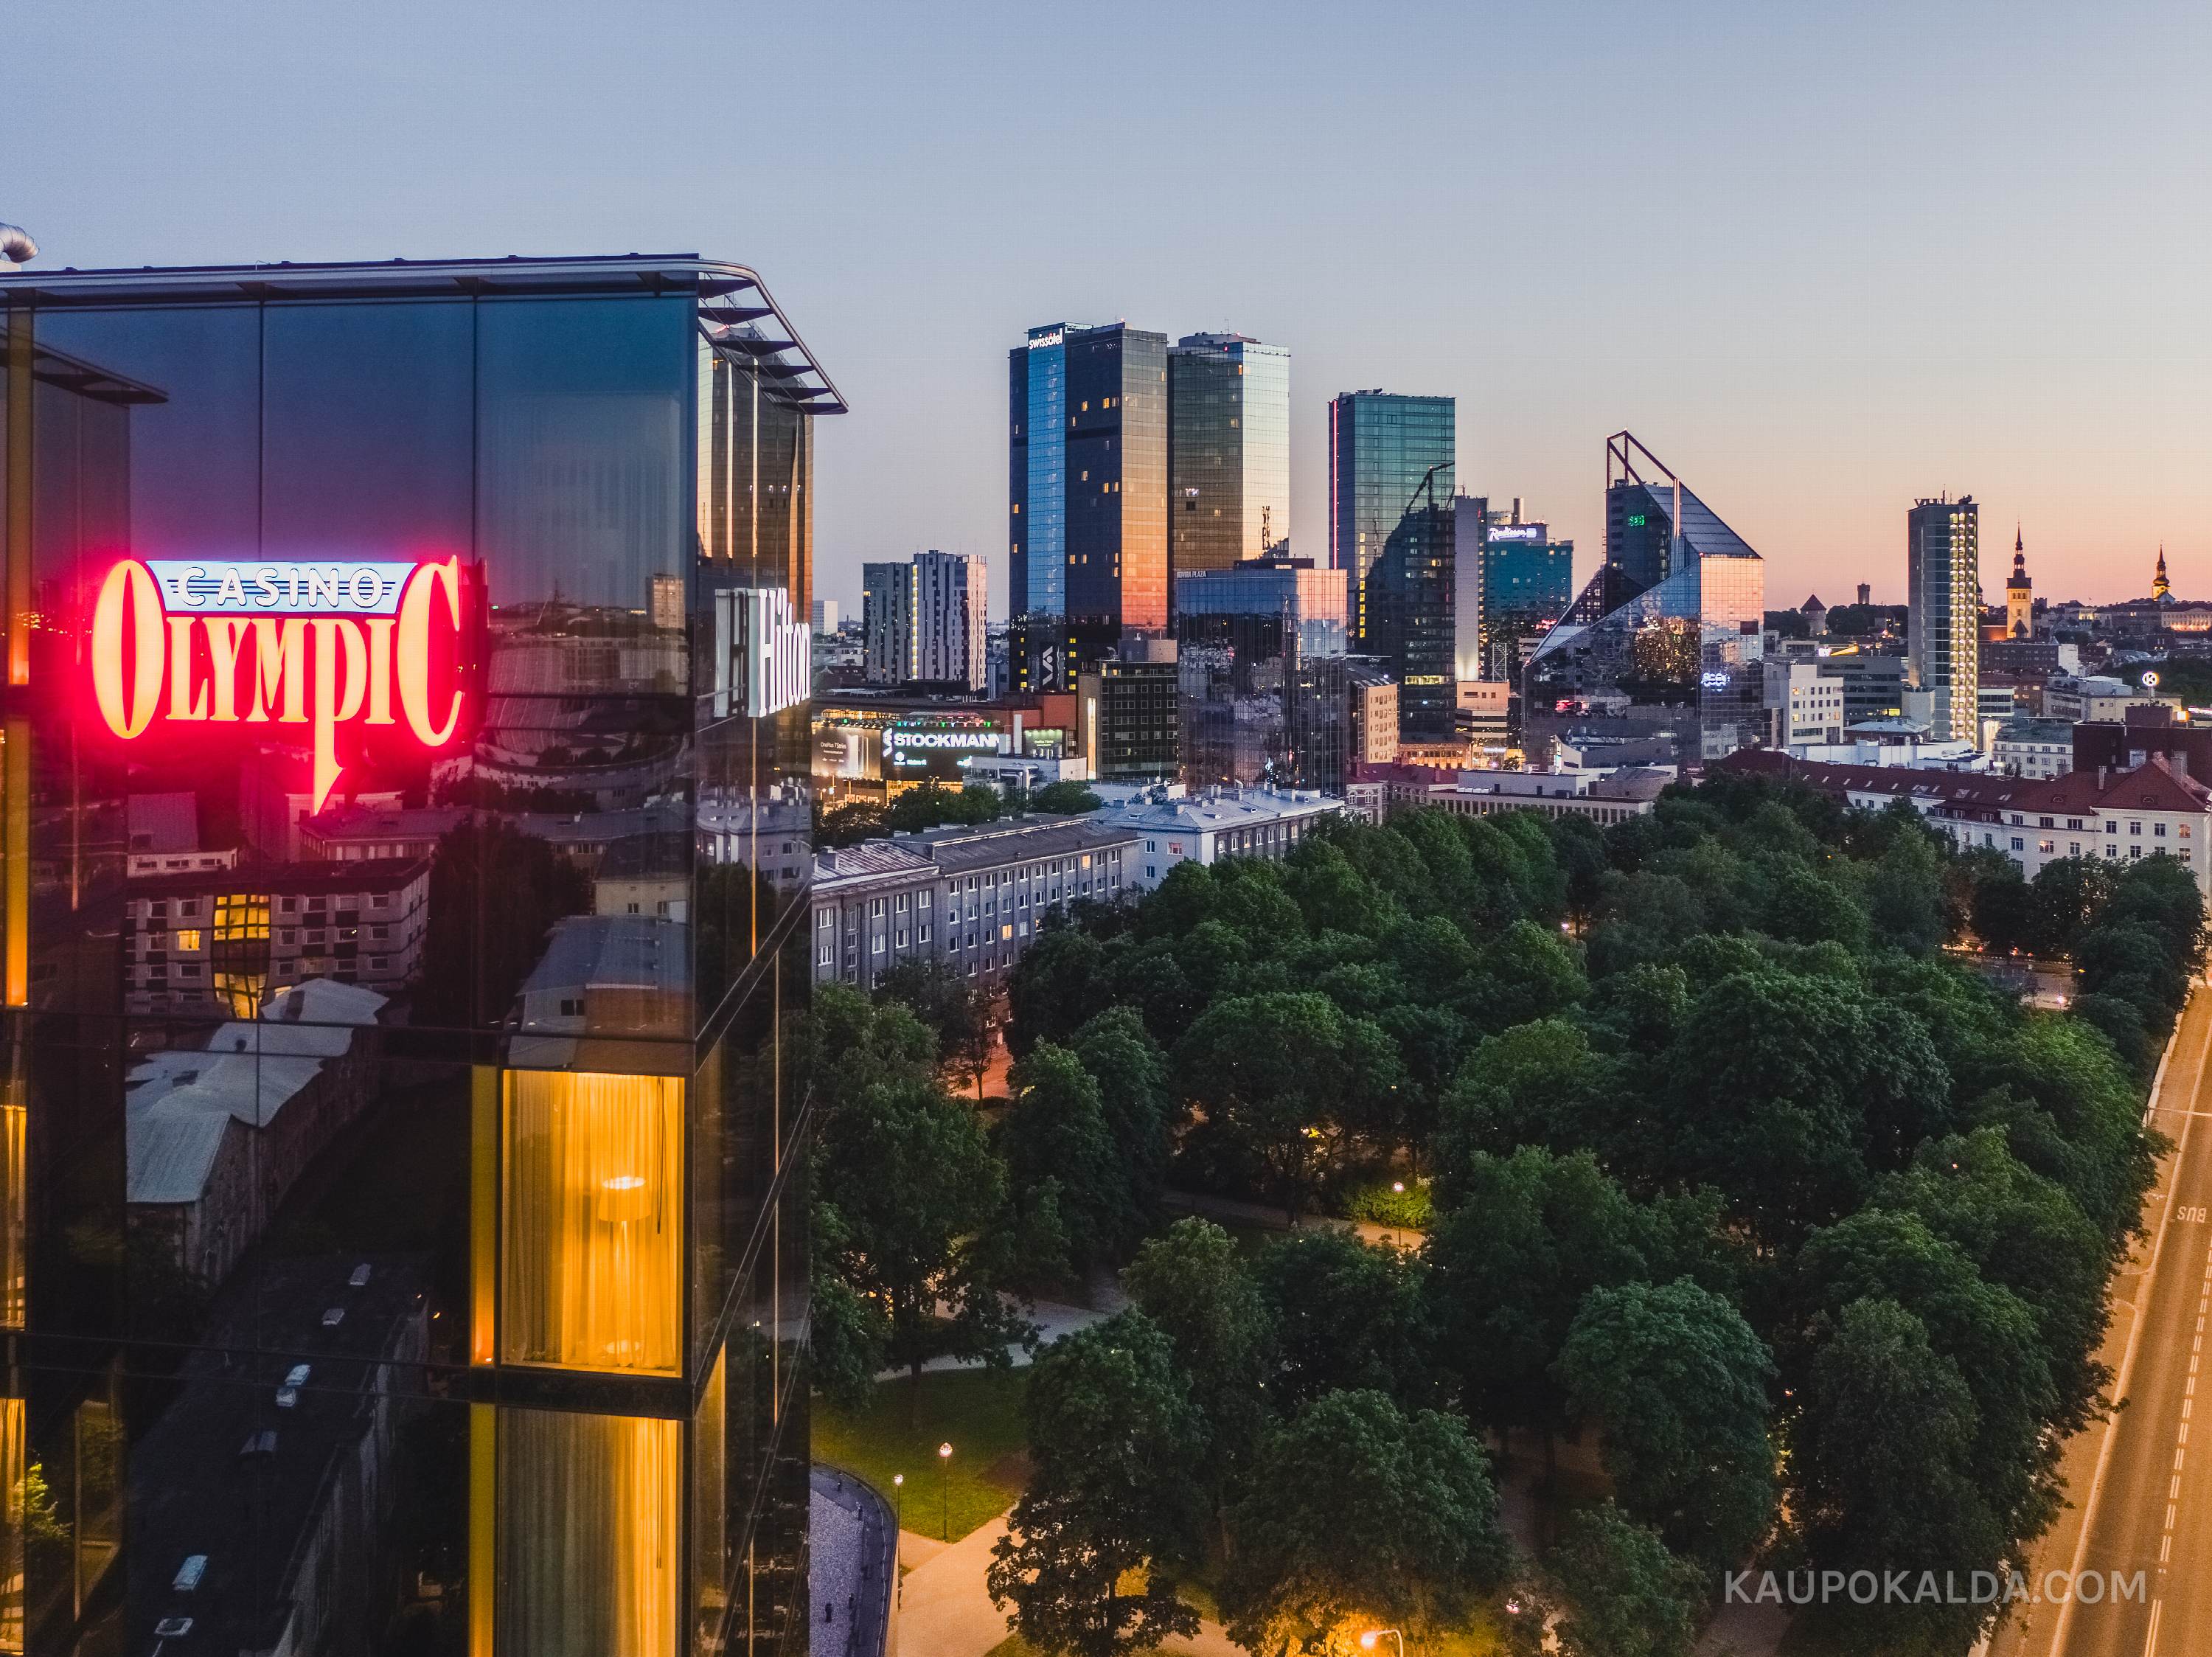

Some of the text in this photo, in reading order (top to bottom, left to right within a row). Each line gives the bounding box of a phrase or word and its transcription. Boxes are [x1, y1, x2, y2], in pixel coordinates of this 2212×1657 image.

[178, 567, 383, 608] CASINO
[758, 588, 810, 718] Hilton
[894, 732, 1000, 748] STOCKMANN
[2177, 1206, 2207, 1223] BUS
